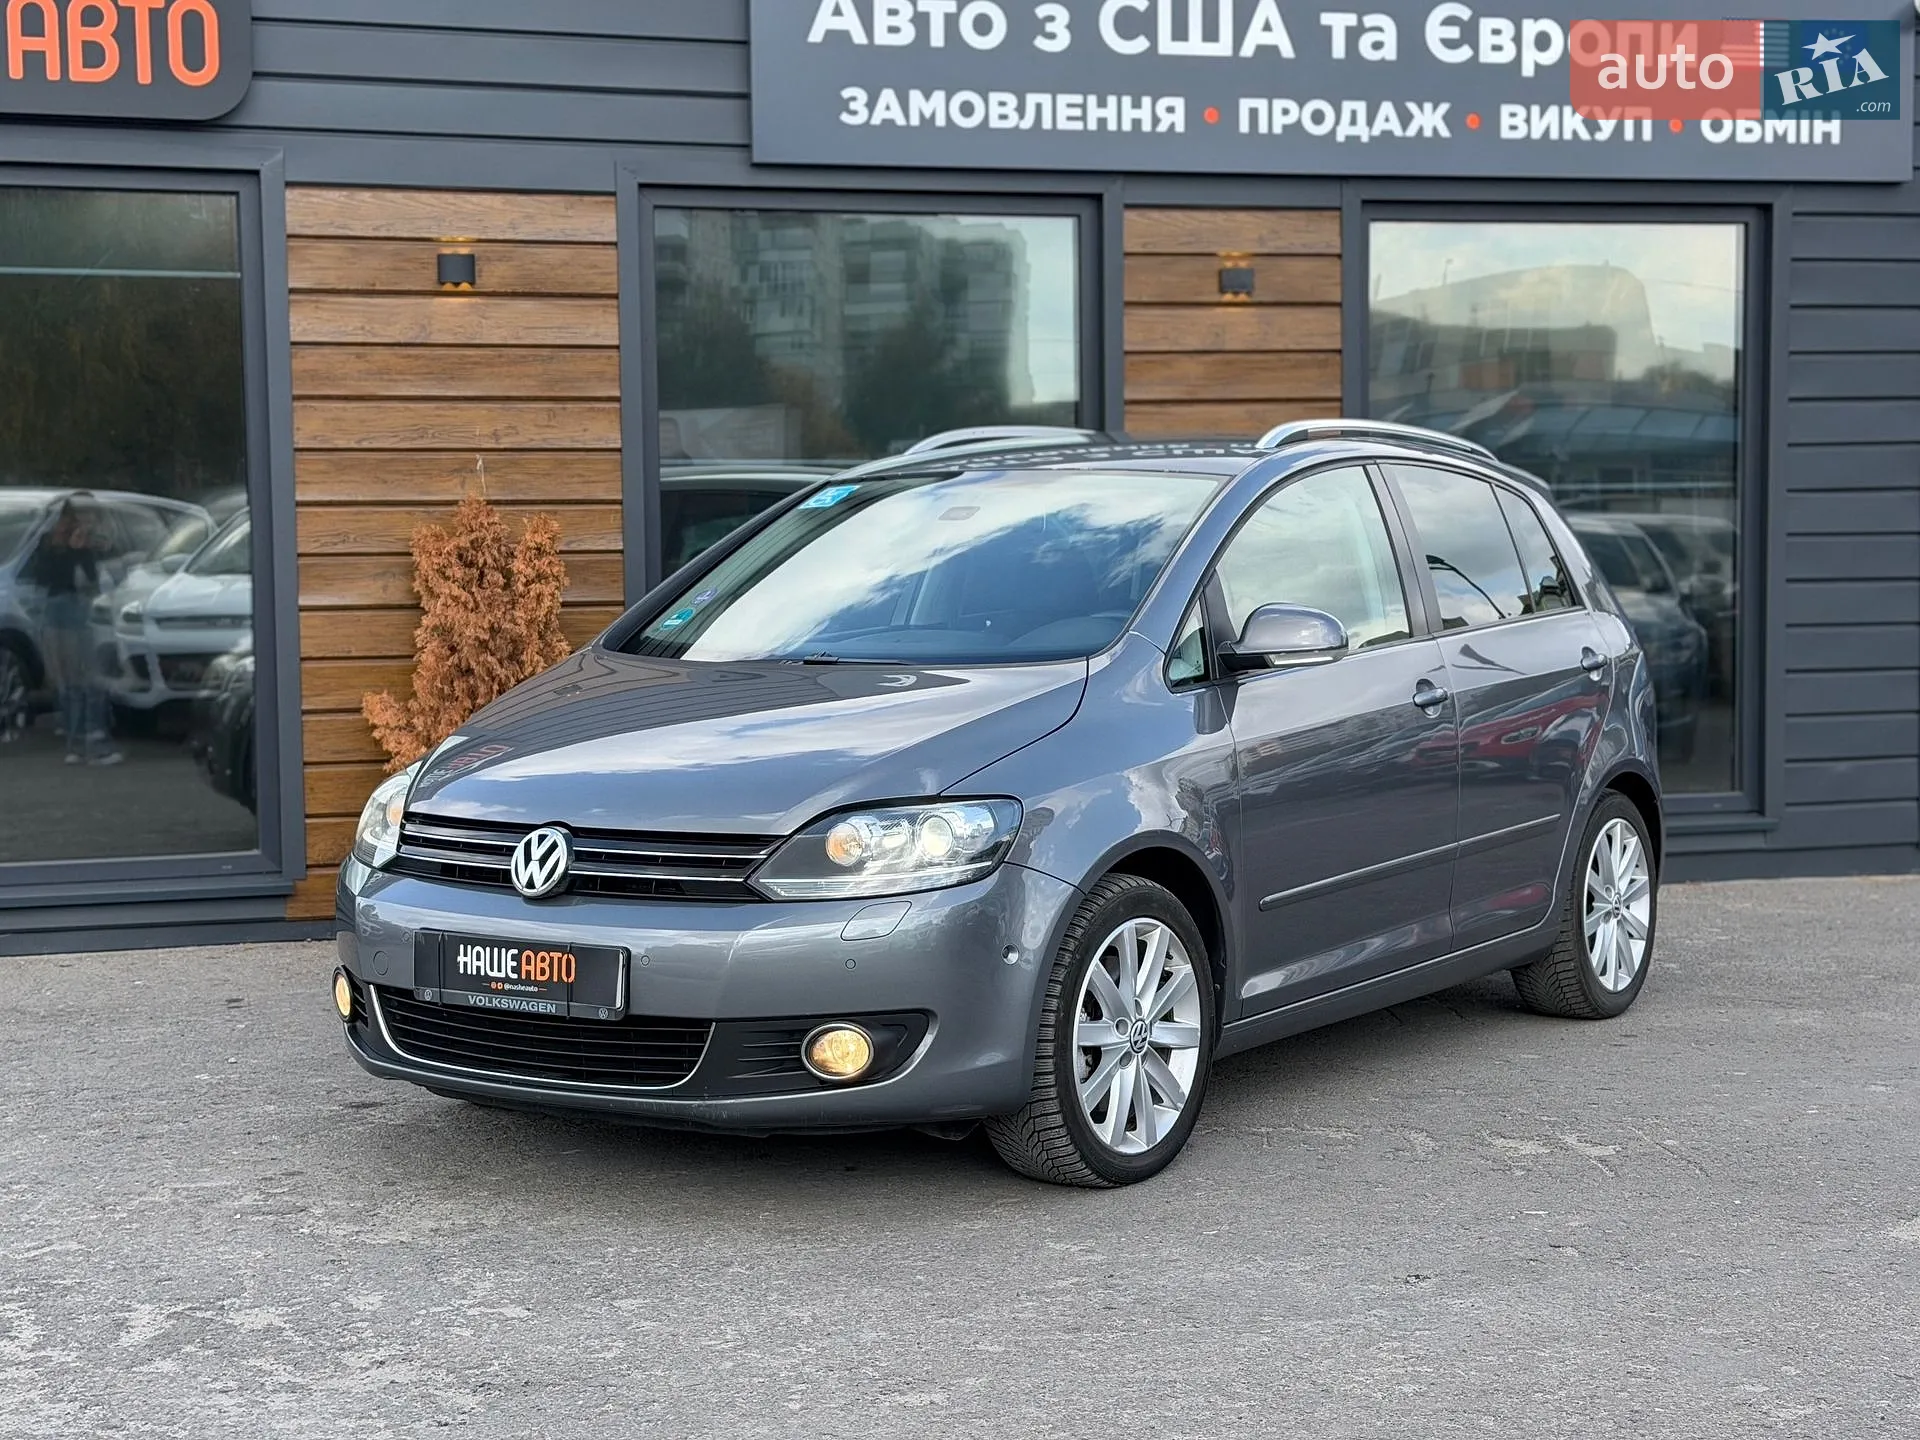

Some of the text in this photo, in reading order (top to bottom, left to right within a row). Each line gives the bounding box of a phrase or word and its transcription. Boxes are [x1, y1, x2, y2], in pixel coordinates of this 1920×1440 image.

[6, 0, 220, 87] АВТО
[807, 0, 1007, 50] Авто
[1099, 0, 1295, 58] США
[1319, 12, 1398, 61] та
[1424, 2, 1698, 77] Європи
[840, 87, 1841, 144] ЗАМОВЛЕННЯ ПРОДАЖ ВИКУП ОБМІН
[457, 944, 576, 983] НАШЕ АВТО
[468, 995, 556, 1013] VOLKSWAGEN
